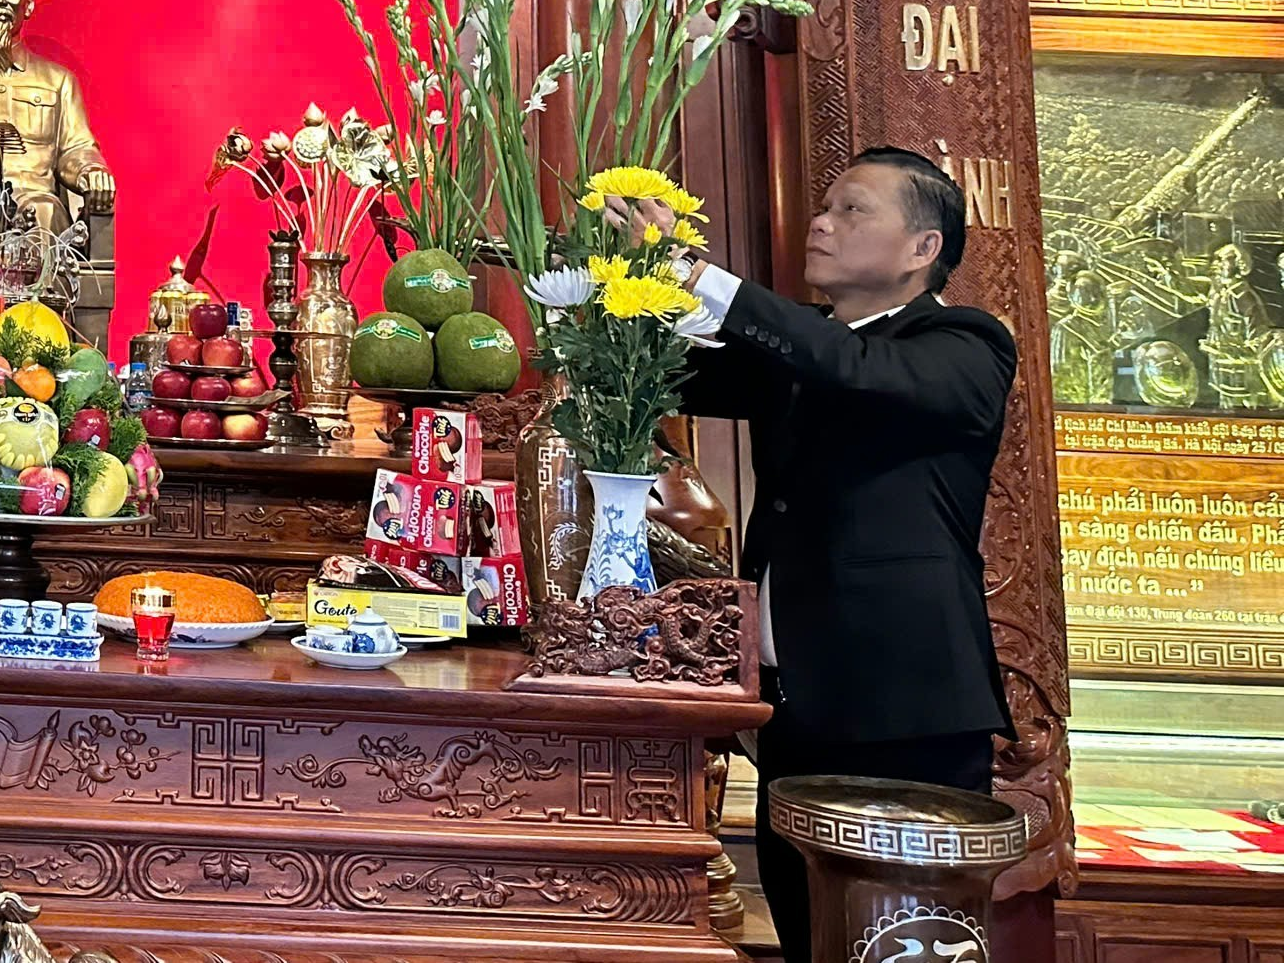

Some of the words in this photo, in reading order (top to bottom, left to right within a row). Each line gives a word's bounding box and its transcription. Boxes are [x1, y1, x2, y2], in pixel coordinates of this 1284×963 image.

[900, 2, 981, 87] ĐẠI
[1058, 488, 1095, 511] chú
[1101, 487, 1146, 515] phải
[1152, 492, 1197, 515] luôn
[1203, 493, 1248, 517] luôn
[1078, 516, 1129, 544] sàng
[1135, 518, 1193, 542] chiến
[1096, 546, 1139, 573] địch
[1144, 545, 1180, 570] nếu
[1185, 548, 1244, 576] chúng
[1080, 571, 1133, 595] nước
[1137, 575, 1160, 597] ta
